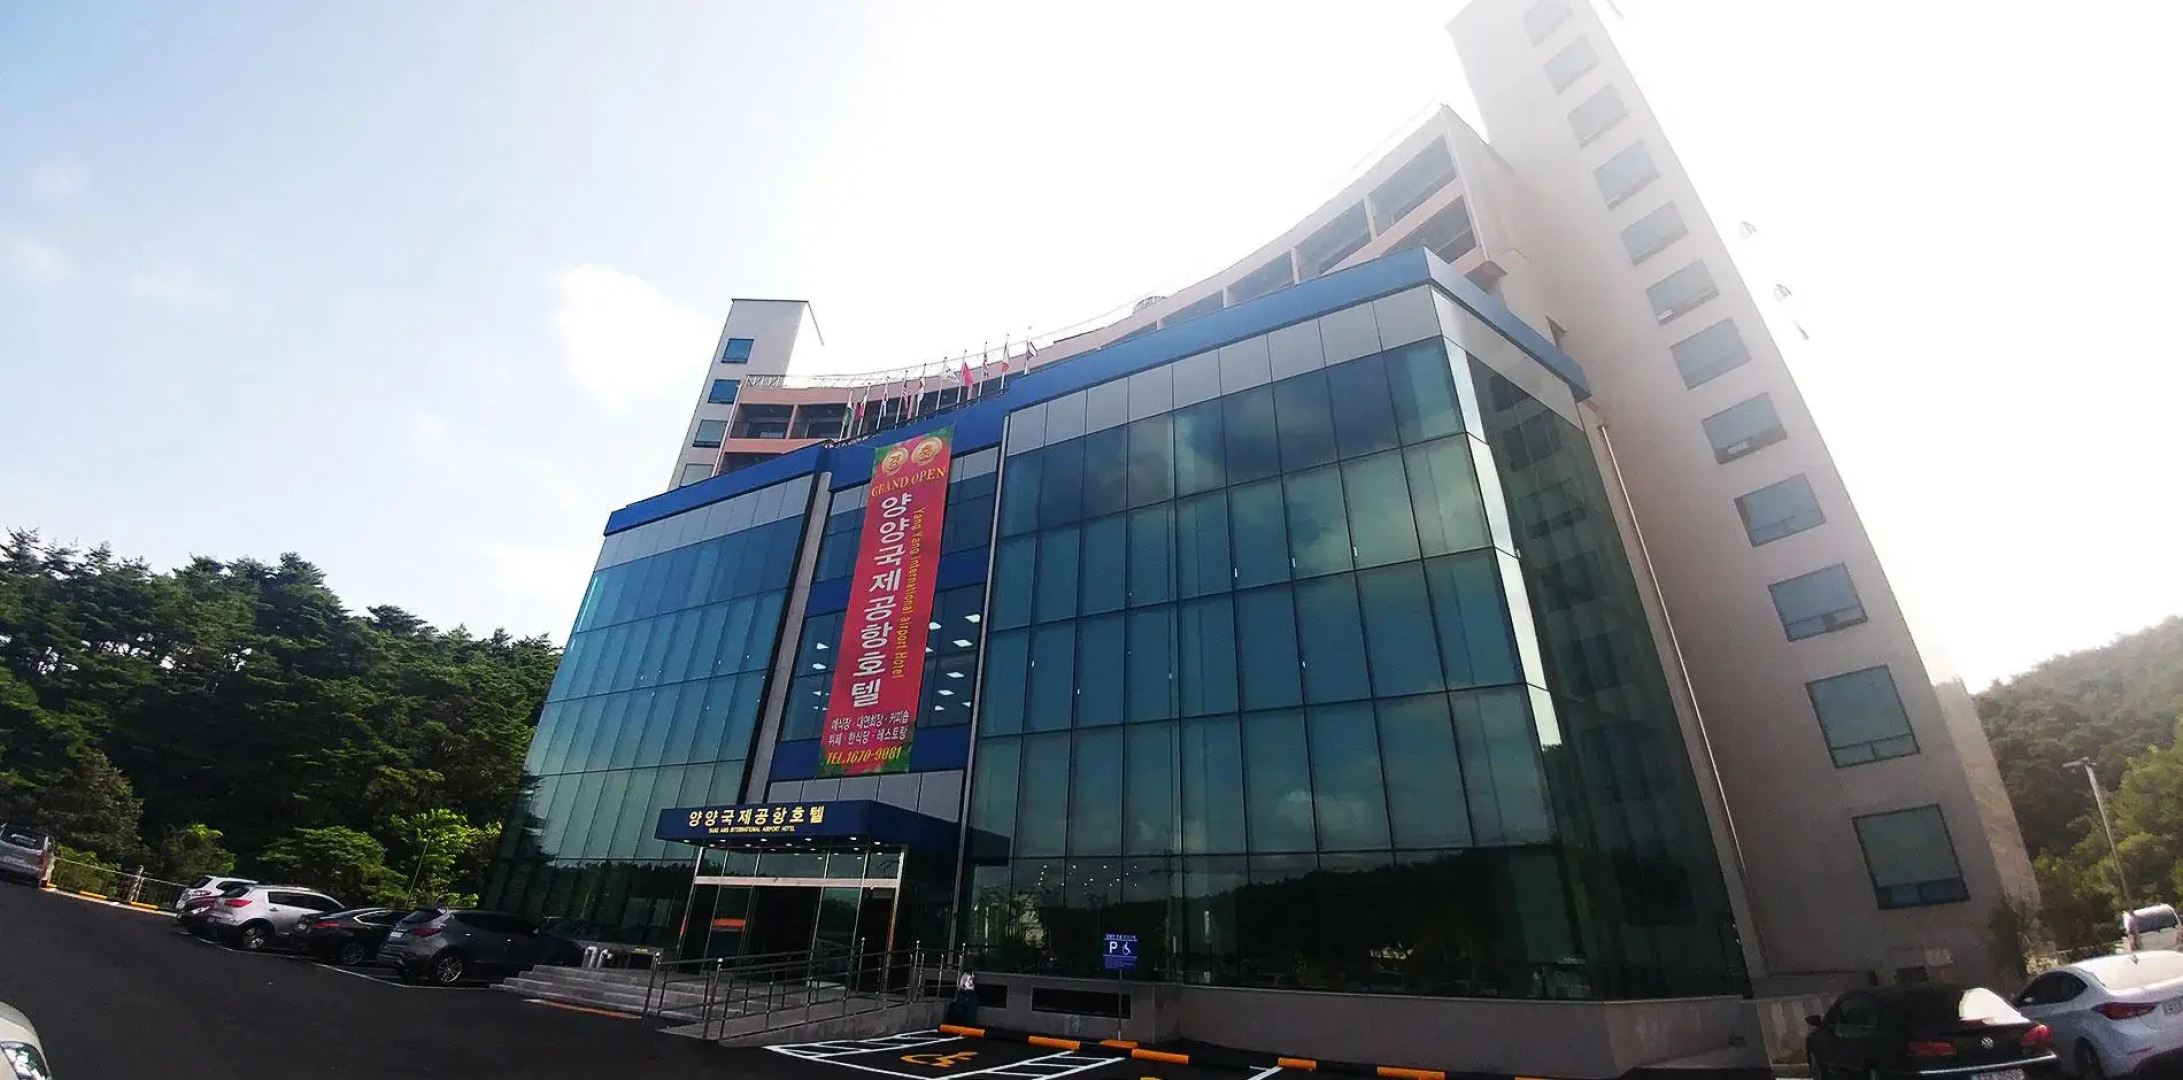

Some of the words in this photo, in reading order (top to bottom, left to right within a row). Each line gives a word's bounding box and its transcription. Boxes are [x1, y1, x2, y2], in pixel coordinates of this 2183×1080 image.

[871, 476, 909, 497] GRAND
[911, 467, 946, 485] OPEN
[911, 507, 926, 530] Yang
[910, 532, 923, 555] Yang
[851, 492, 912, 708] 양양국제공항호텔
[896, 616, 911, 649] airport
[892, 651, 907, 679] Hotel
[877, 725, 908, 741] 레스토랑
[689, 805, 825, 827] 양양국제공항호텔
[1109, 940, 1118, 954] P
